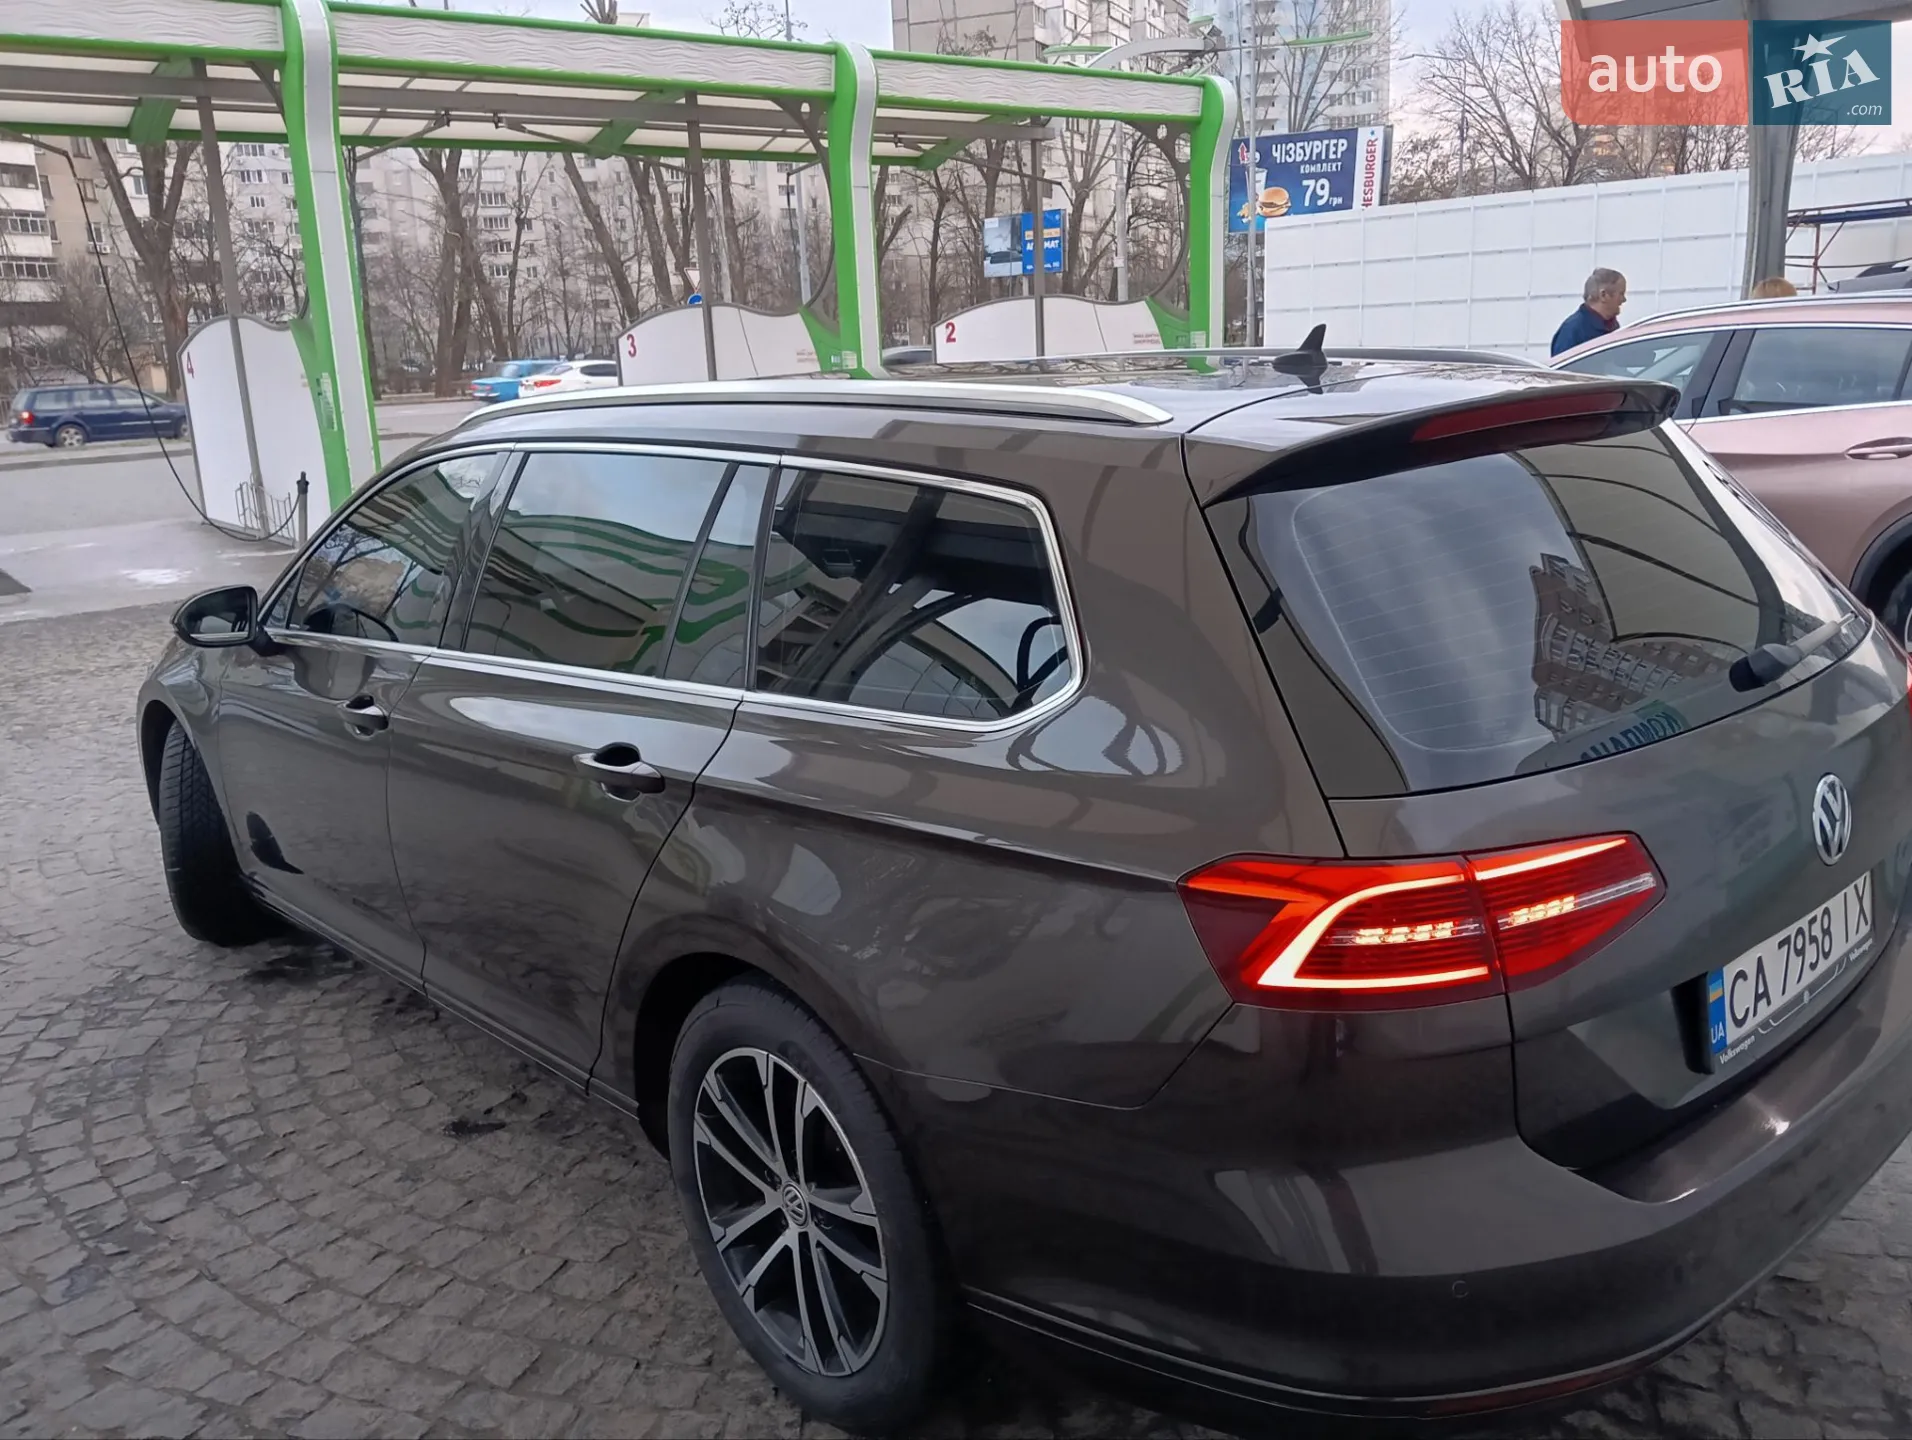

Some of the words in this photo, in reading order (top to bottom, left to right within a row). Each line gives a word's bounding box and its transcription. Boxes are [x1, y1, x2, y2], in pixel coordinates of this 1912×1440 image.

[1271, 138, 1349, 164] ЧІЗБУРГЕР
[1299, 162, 1342, 174] КОМПЛЕКТ
[1301, 178, 1330, 207] 79
[944, 321, 957, 344] 2
[626, 333, 637, 358] 3
[186, 352, 195, 378] 4
[1729, 952, 1772, 1029] CA
[1777, 906, 1833, 997] 7958
[1843, 874, 1869, 944] IX
[1710, 1021, 1726, 1044] UA
